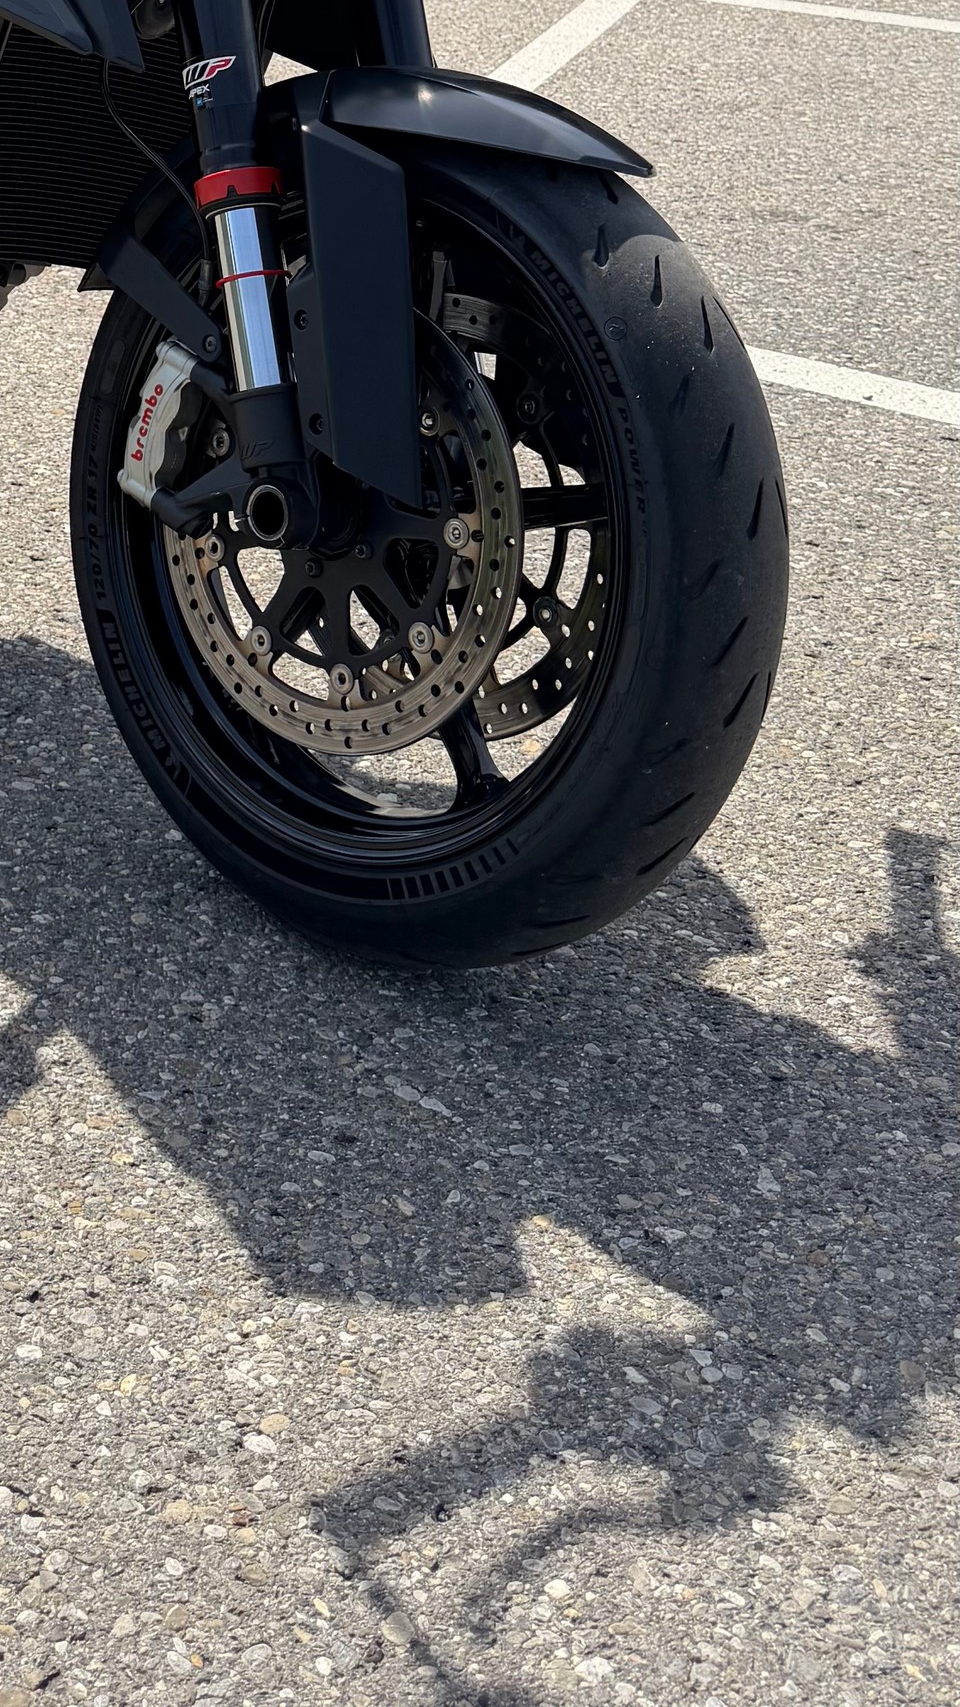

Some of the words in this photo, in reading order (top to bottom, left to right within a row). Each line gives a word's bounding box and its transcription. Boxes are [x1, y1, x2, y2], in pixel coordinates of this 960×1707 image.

[530, 249, 618, 383] MICHELIN
[131, 384, 163, 462] brembo
[618, 406, 647, 514] POWER
[86, 485, 98, 516] ZR
[88, 456, 99, 481] 17
[87, 523, 107, 601] 120/70
[102, 621, 167, 752] MICHELIN
